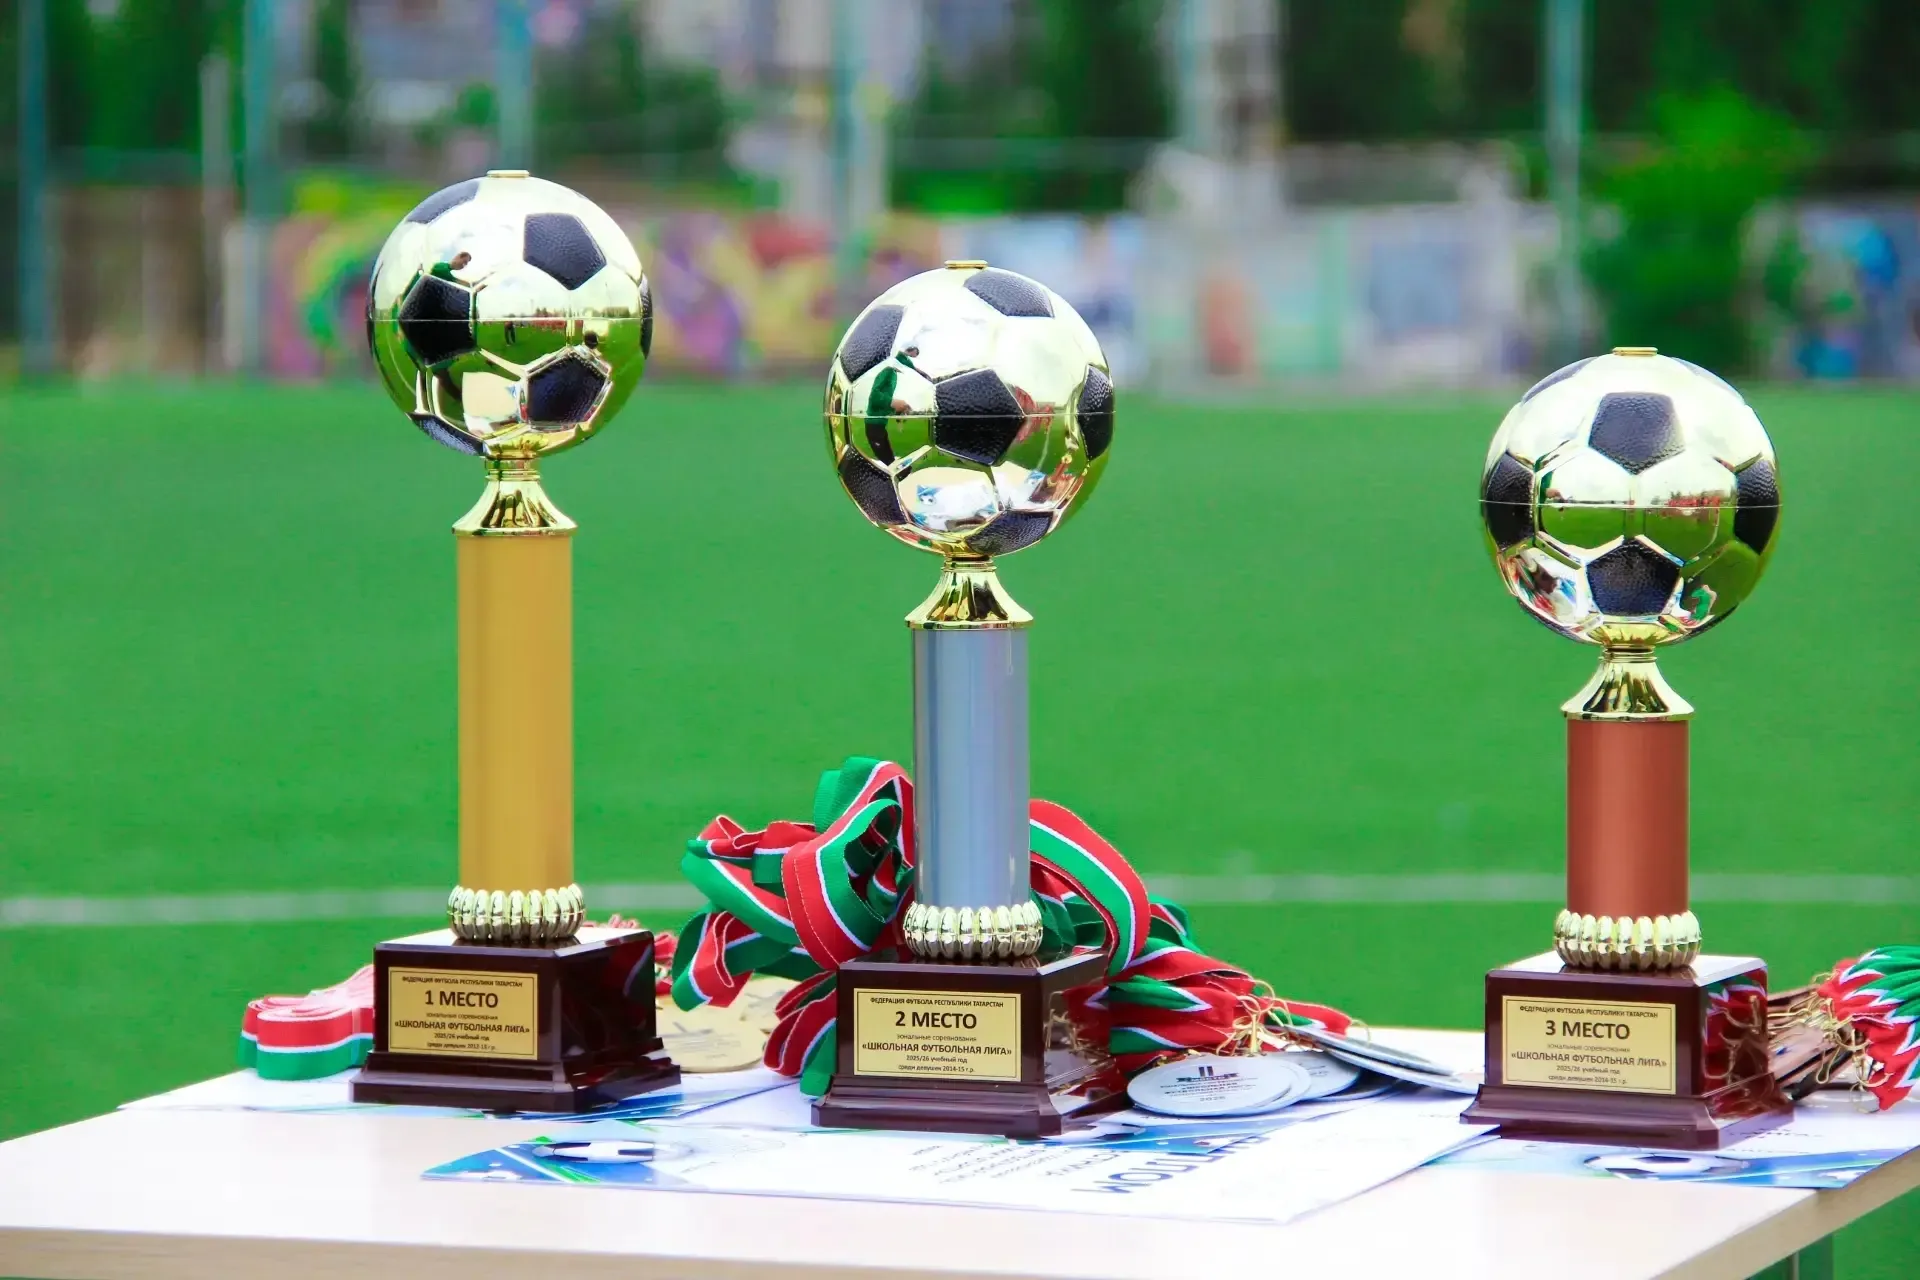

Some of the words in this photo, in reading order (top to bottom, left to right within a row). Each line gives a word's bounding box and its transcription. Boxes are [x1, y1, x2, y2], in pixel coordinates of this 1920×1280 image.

[425, 990, 434, 1005] 1
[440, 991, 498, 1008] МЕСТО
[906, 998, 933, 1006] ФУТБОЛА
[395, 1020, 446, 1029] «ШКОЛЬНАЯ
[448, 1022, 502, 1032] ФУТБОЛЬНАЯ
[504, 1025, 530, 1033] ЛИГА»
[895, 1011, 906, 1027] 2
[912, 1012, 977, 1029] МЕСТО
[1546, 1020, 1556, 1036] 3
[1563, 1021, 1630, 1040] МЕСТО
[862, 1042, 919, 1052] «ШКОЛЬНАЯ
[922, 1044, 982, 1054] ФУТБОЛЬНАЯ
[984, 1046, 1012, 1056] ЛИГА»
[1512, 1050, 1570, 1061] «ШКОЛЬНАЯ
[1572, 1054, 1635, 1066] ФУТБОЛЬНАЯ
[1638, 1058, 1667, 1067] ЛИГА»
